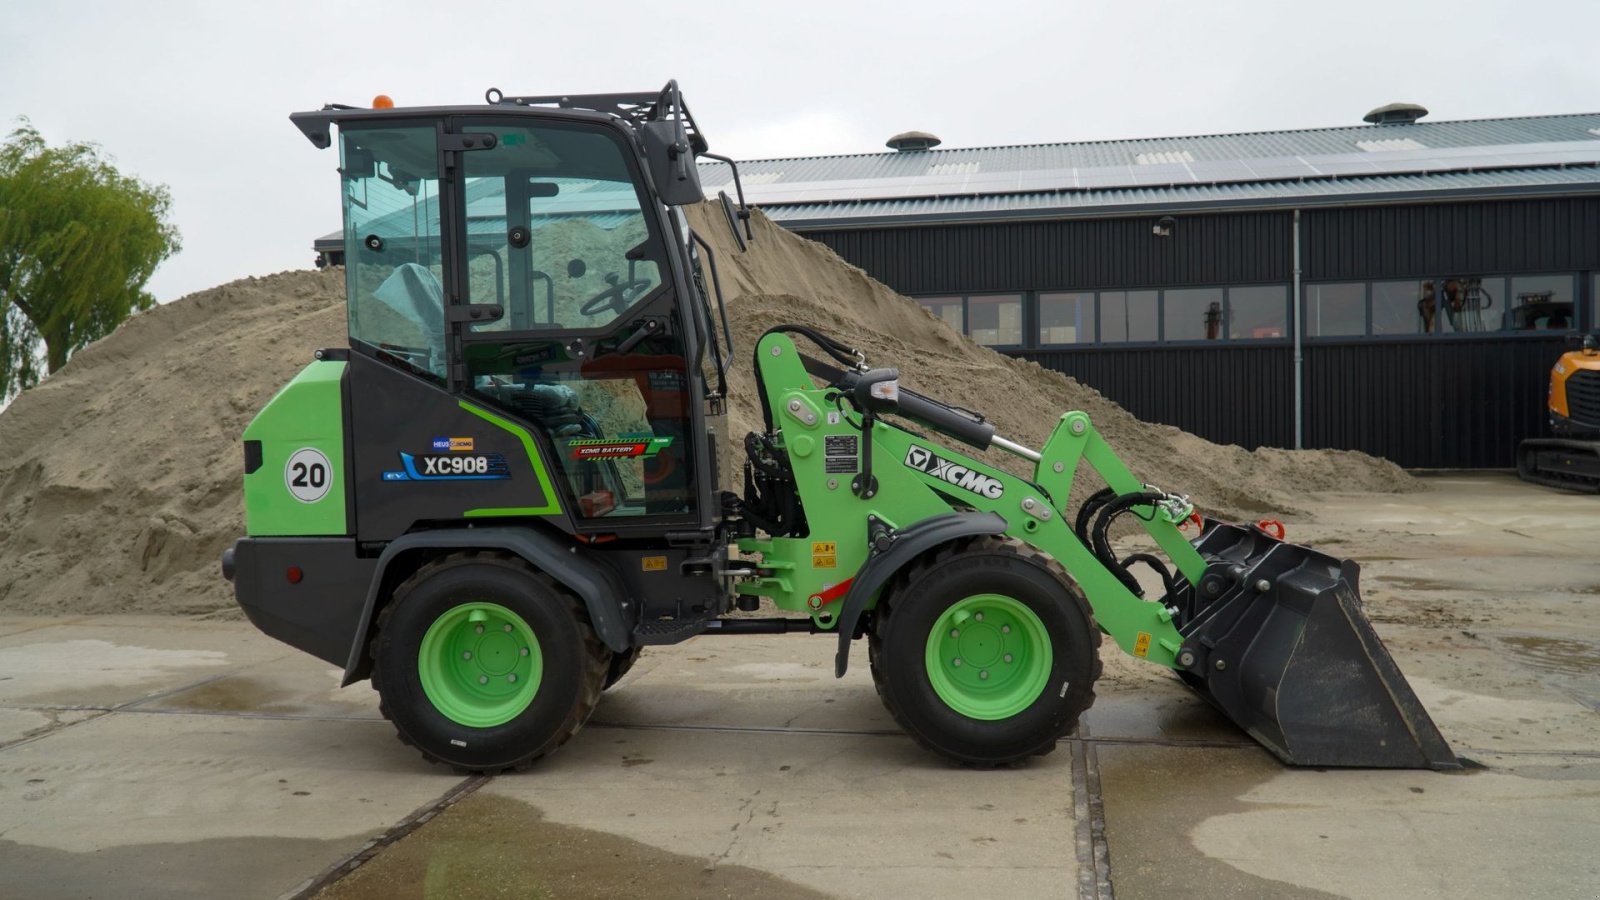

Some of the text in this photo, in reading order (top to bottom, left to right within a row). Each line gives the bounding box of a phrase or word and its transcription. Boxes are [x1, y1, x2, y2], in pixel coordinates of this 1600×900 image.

[601, 446, 634, 454] BATTERY
[292, 462, 325, 488] 20
[424, 456, 488, 475] XC908
[926, 456, 1004, 500] XCMG
